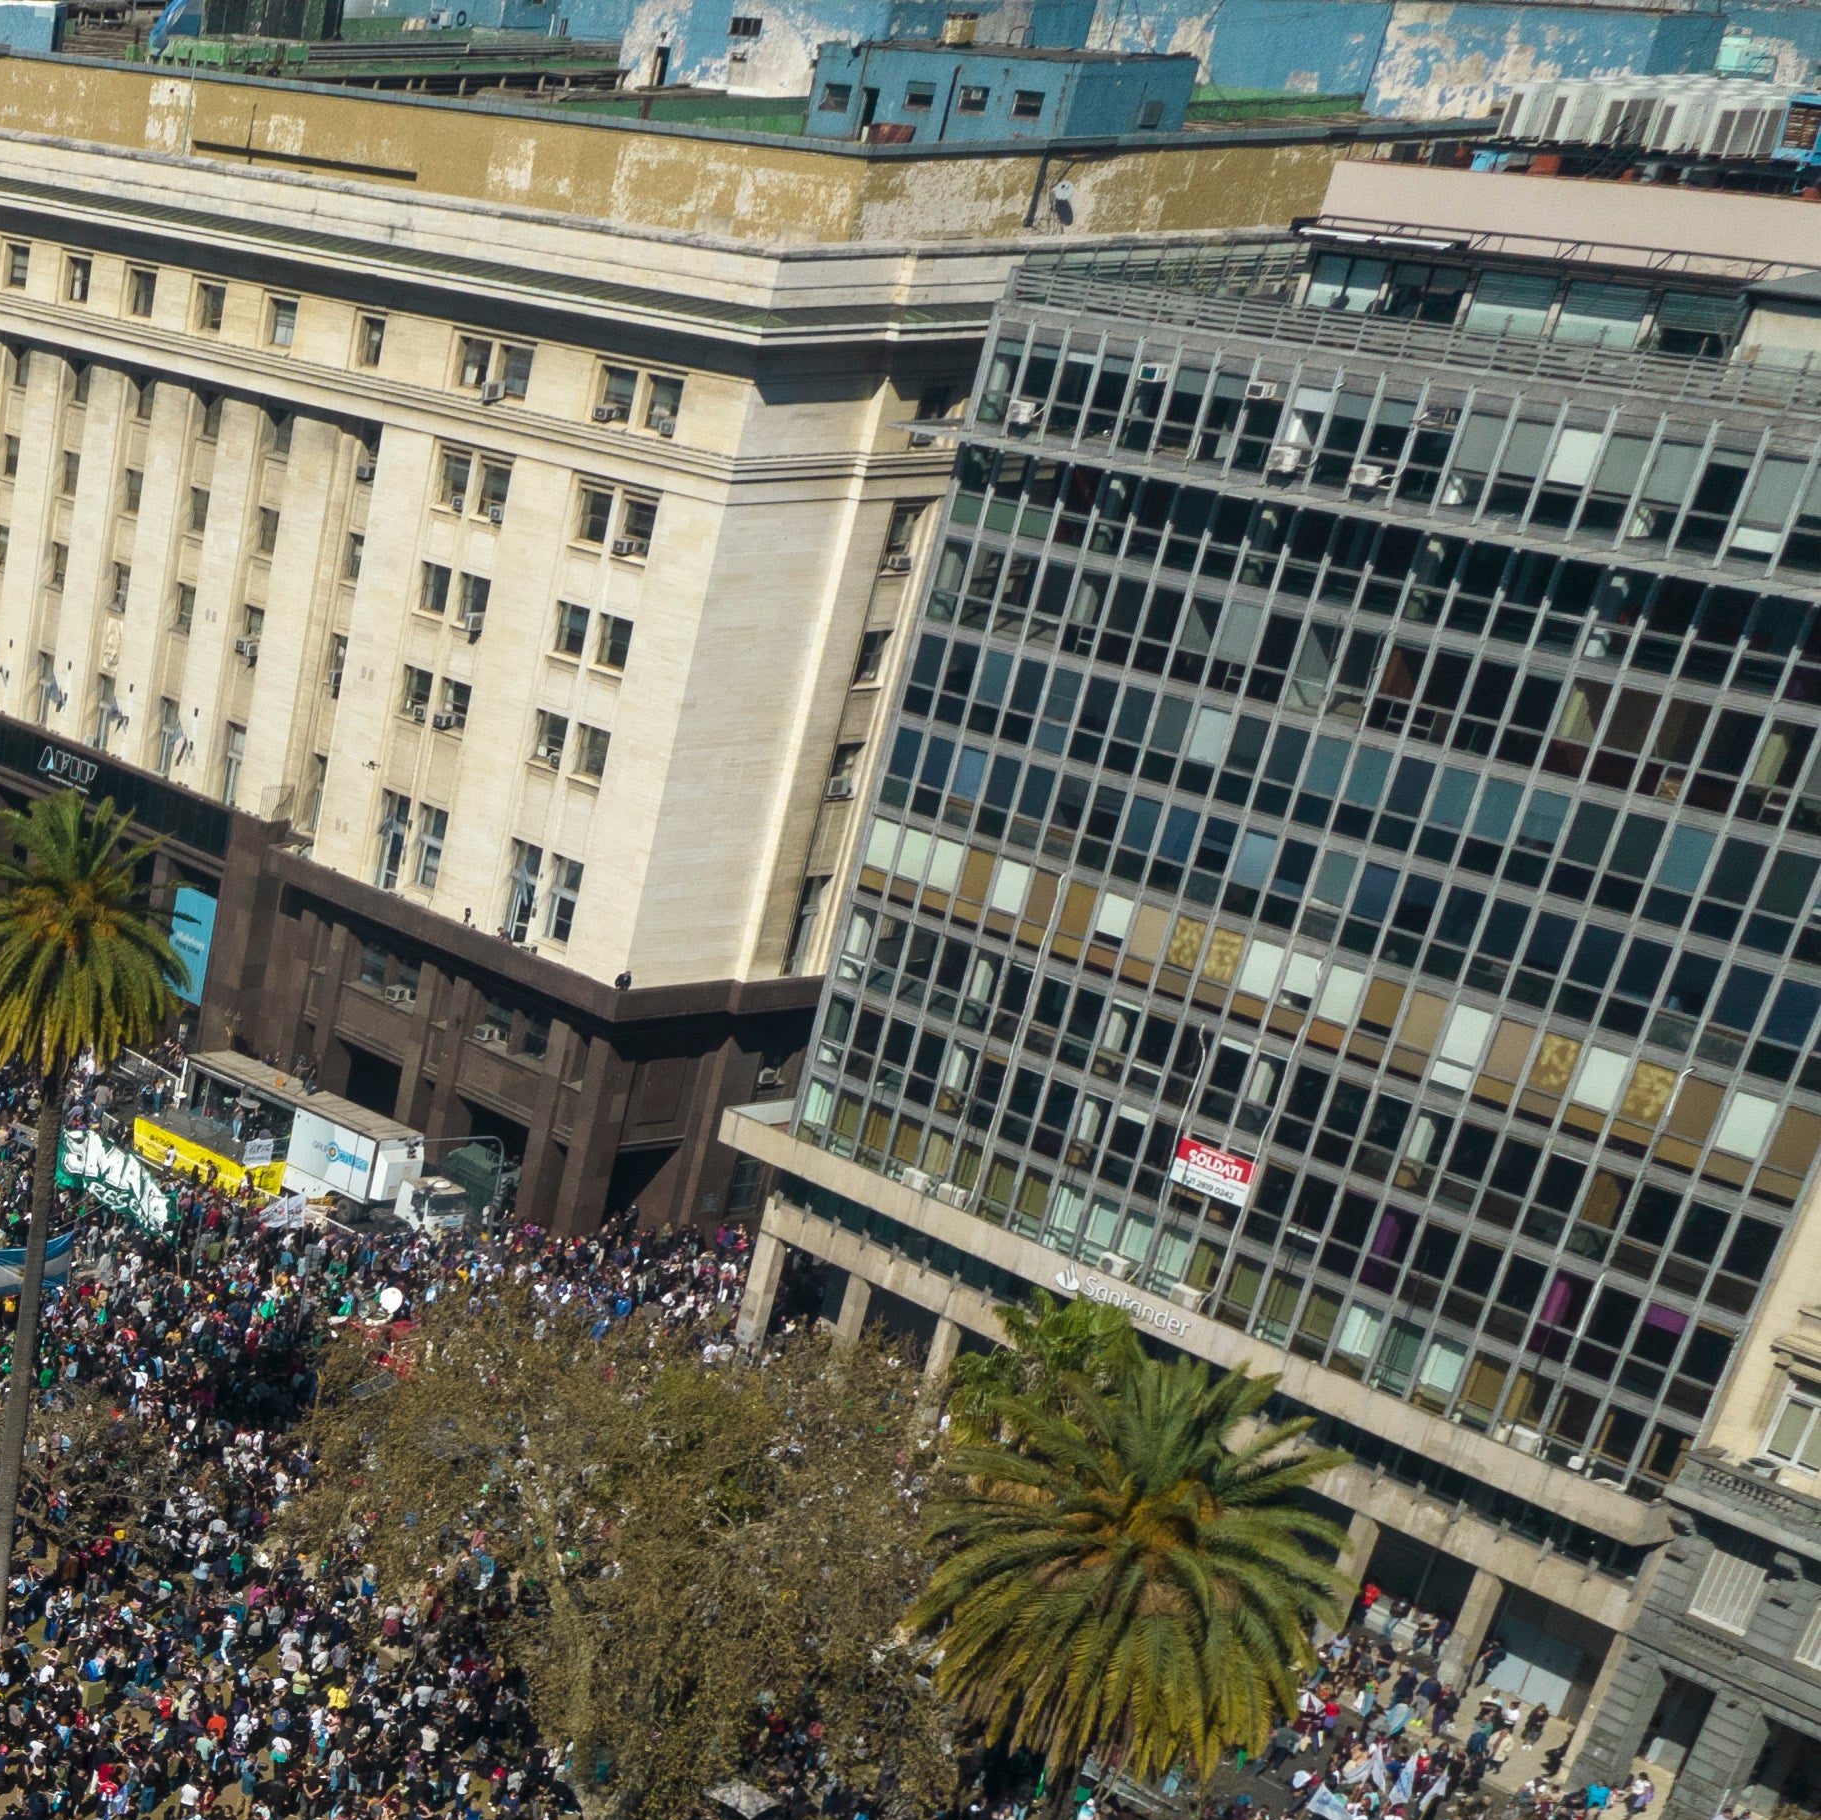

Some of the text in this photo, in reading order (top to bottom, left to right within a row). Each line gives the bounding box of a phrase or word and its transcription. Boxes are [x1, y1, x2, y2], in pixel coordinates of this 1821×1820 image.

[38, 745, 97, 785] AFIP
[1188, 1149, 1243, 1180] SOLDATI
[1083, 1275, 1191, 1338] Santander
